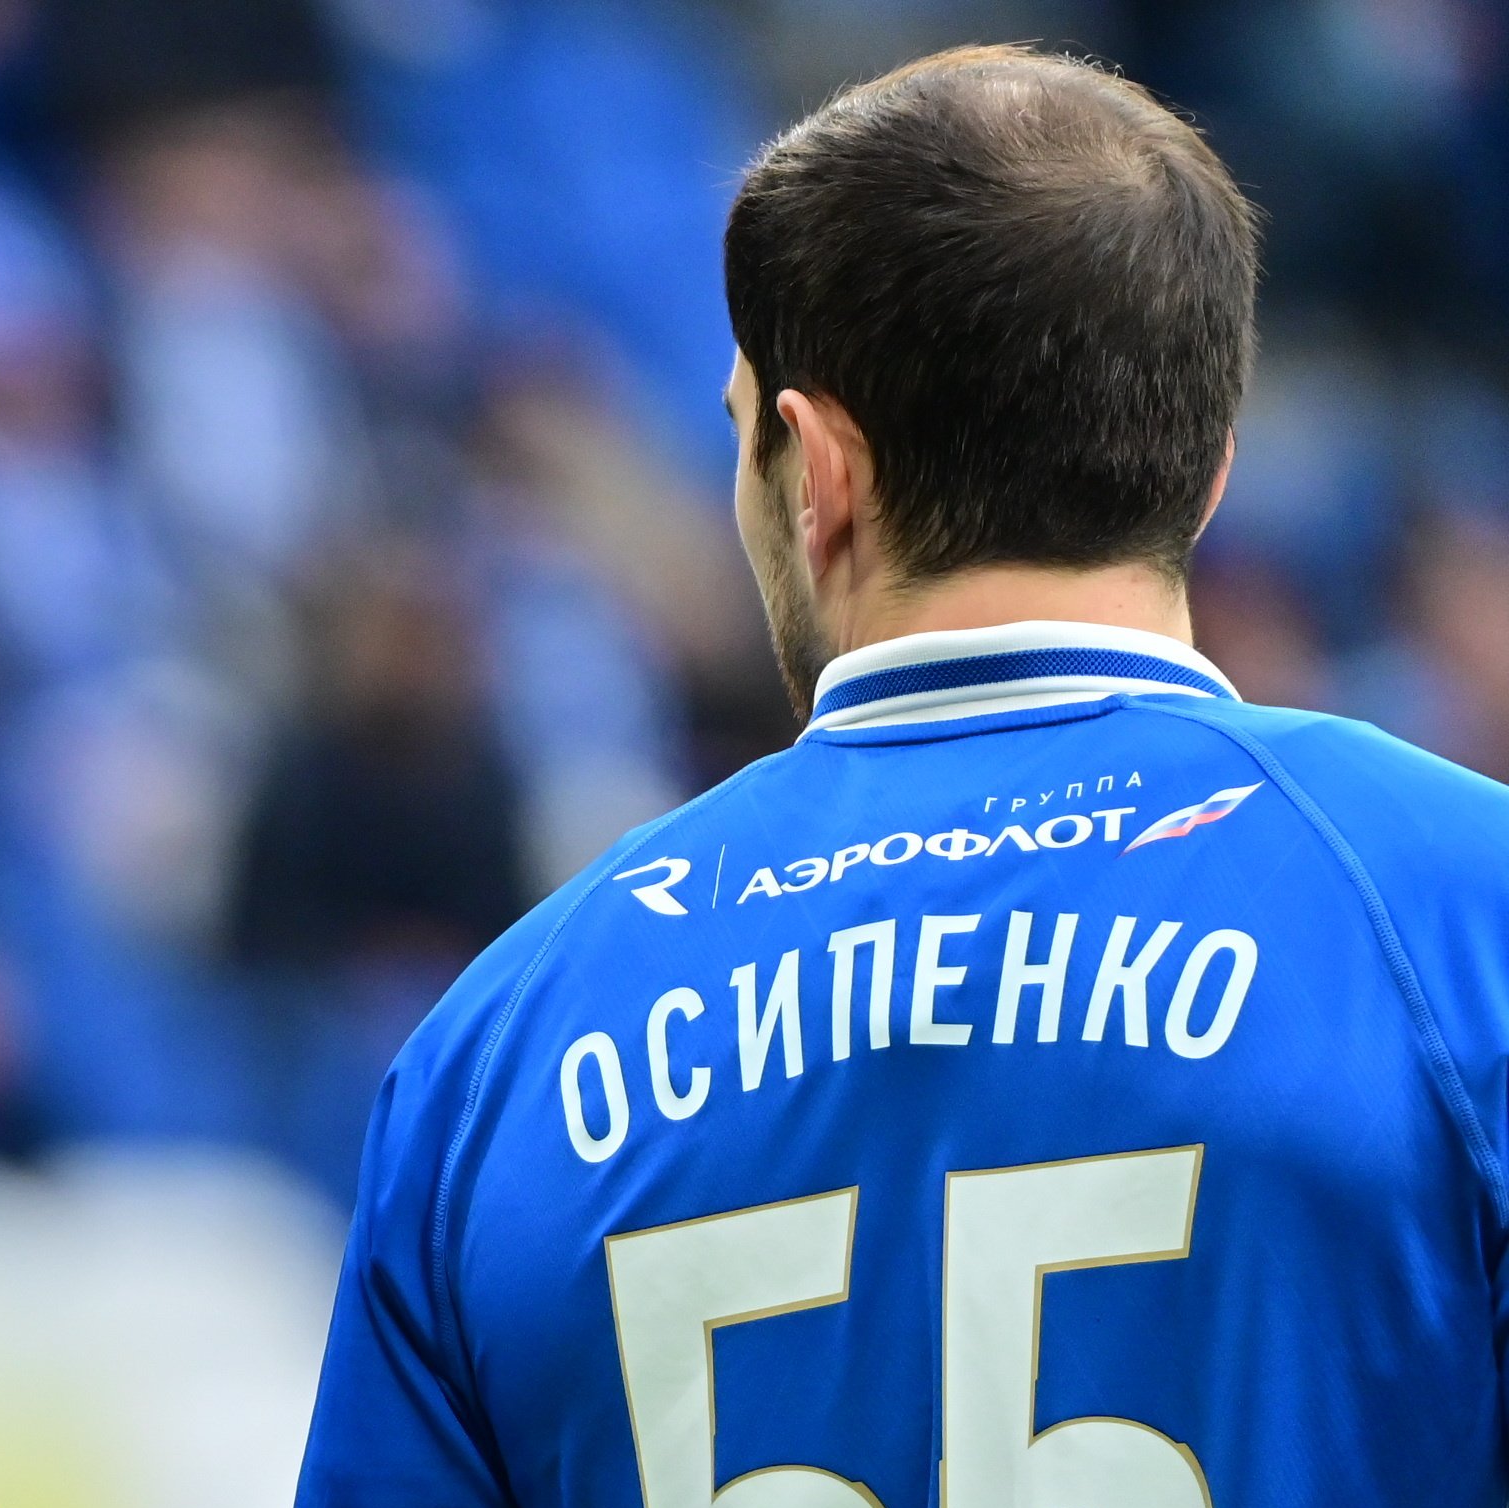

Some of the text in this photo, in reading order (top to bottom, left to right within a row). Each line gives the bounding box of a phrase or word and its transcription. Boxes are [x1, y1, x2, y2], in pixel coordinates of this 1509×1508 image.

[984, 770, 1143, 813] ГРУППА
[737, 806, 1136, 905] АЭРОФЛОТ
[559, 910, 1259, 1163] ОСИПЕНКО
